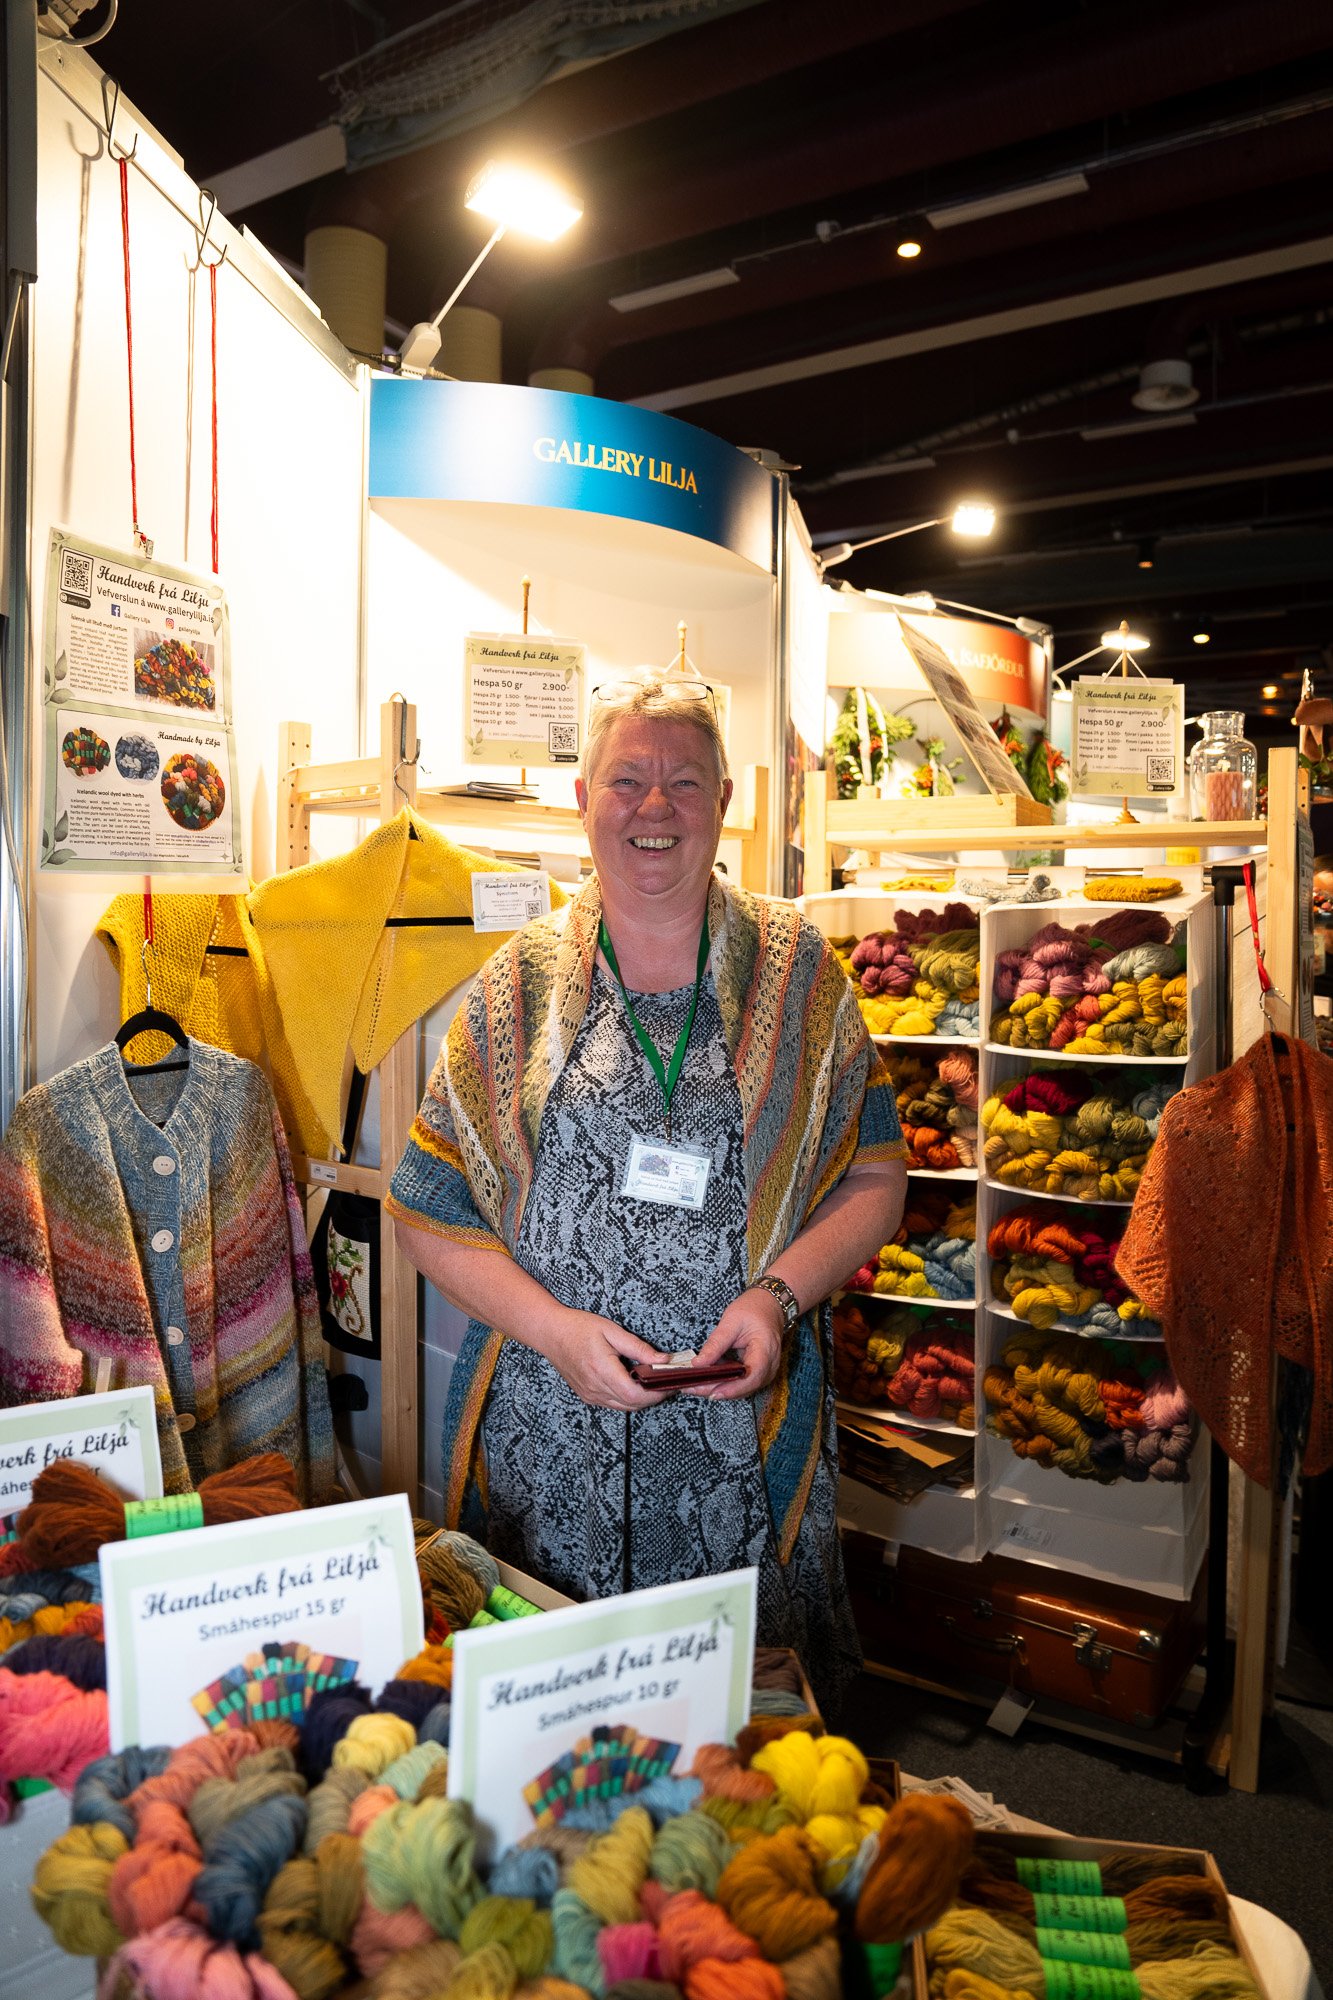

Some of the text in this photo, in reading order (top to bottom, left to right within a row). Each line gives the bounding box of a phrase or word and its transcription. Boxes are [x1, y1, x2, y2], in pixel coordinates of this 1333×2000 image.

[533, 438, 698, 494] GALLERY LILJA
[97, 566, 209, 609] Handverk frá Lilju
[97, 586, 214, 624] Vefverslun á www.gallerylilja.is
[480, 647, 559, 662] Handverk frá Lilju
[474, 679, 500, 688] Hespa
[542, 683, 570, 691] 2.900-
[1085, 690, 1157, 702] Handverk frá Lilju
[158, 732, 221, 747] Handmade by Lilja
[44, 1440, 73, 1466] frá
[81, 1433, 129, 1454] Lilju
[141, 1554, 379, 1620] Handverk frá Lilju
[198, 1596, 346, 1641] Smáhespur 15 gr
[487, 1656, 609, 1710] Handverk
[616, 1646, 654, 1678] frá
[538, 1680, 681, 1731] Smáhespur 10 gr
